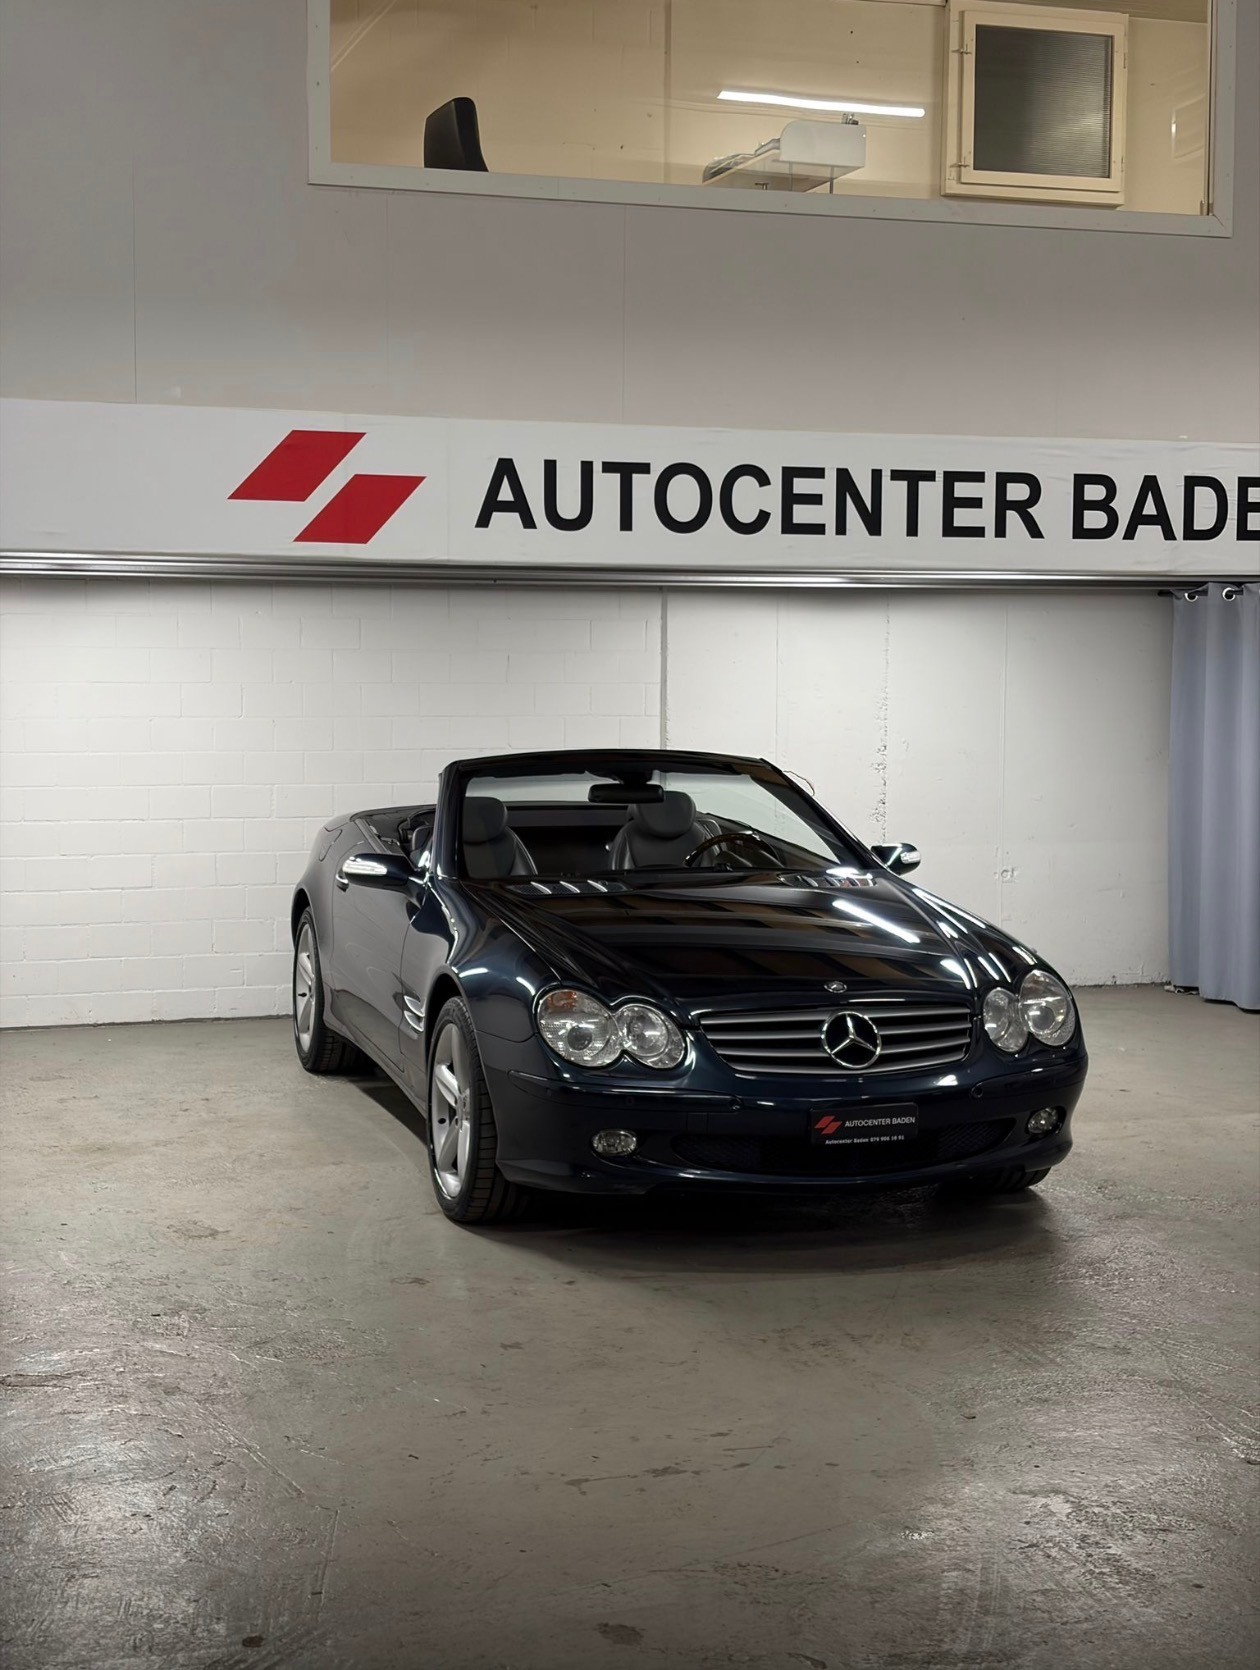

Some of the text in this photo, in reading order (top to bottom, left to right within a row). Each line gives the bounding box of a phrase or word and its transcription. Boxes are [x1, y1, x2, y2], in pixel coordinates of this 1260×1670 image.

[474, 457, 1260, 541] AUTOCENTER BADE
[845, 1118, 890, 1127] AUTOCENTER
